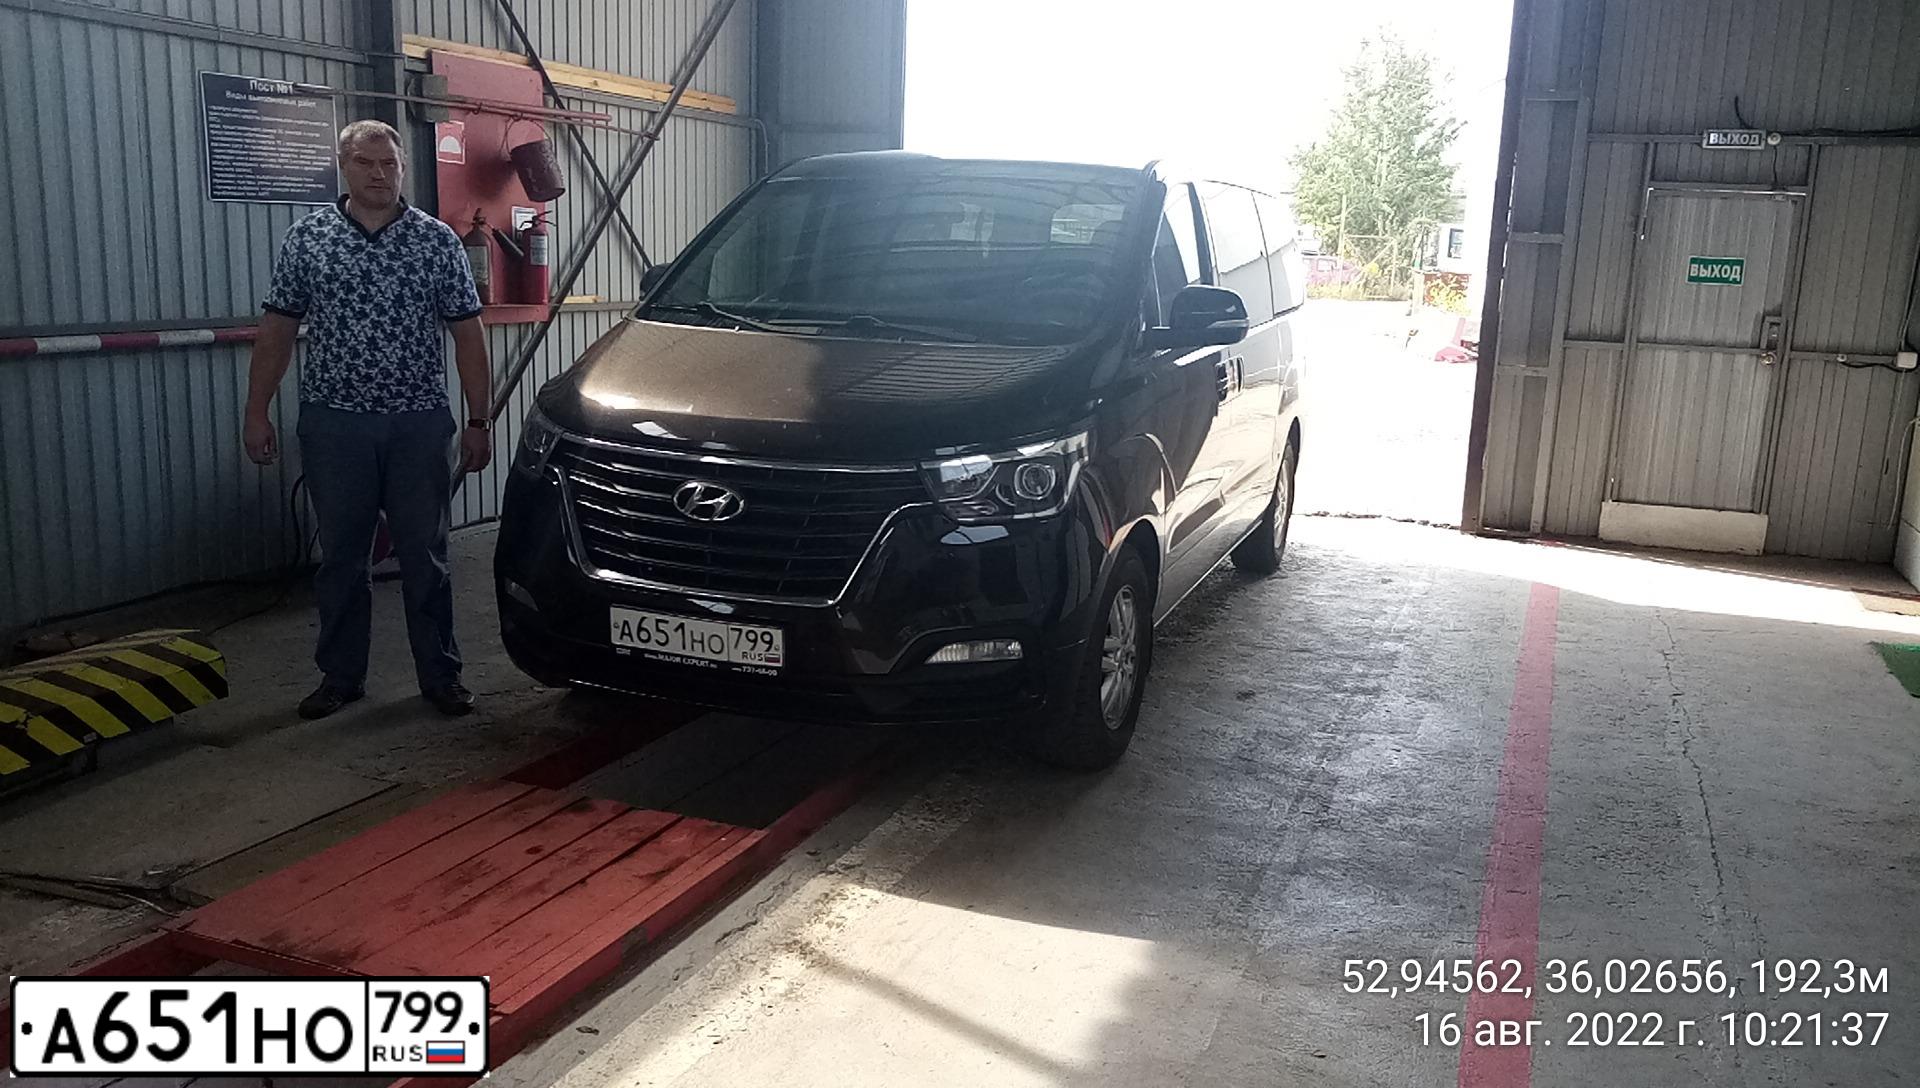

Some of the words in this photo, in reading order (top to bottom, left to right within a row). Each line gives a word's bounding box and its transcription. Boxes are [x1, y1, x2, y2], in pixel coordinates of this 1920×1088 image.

[249, 80, 274, 92] Пост
[1709, 132, 1760, 145] ВЫХОД
[1690, 263, 1742, 282] ВЫХОД
[619, 616, 725, 655] А651НО
[730, 627, 774, 653] 799
[742, 651, 763, 662] RUS
